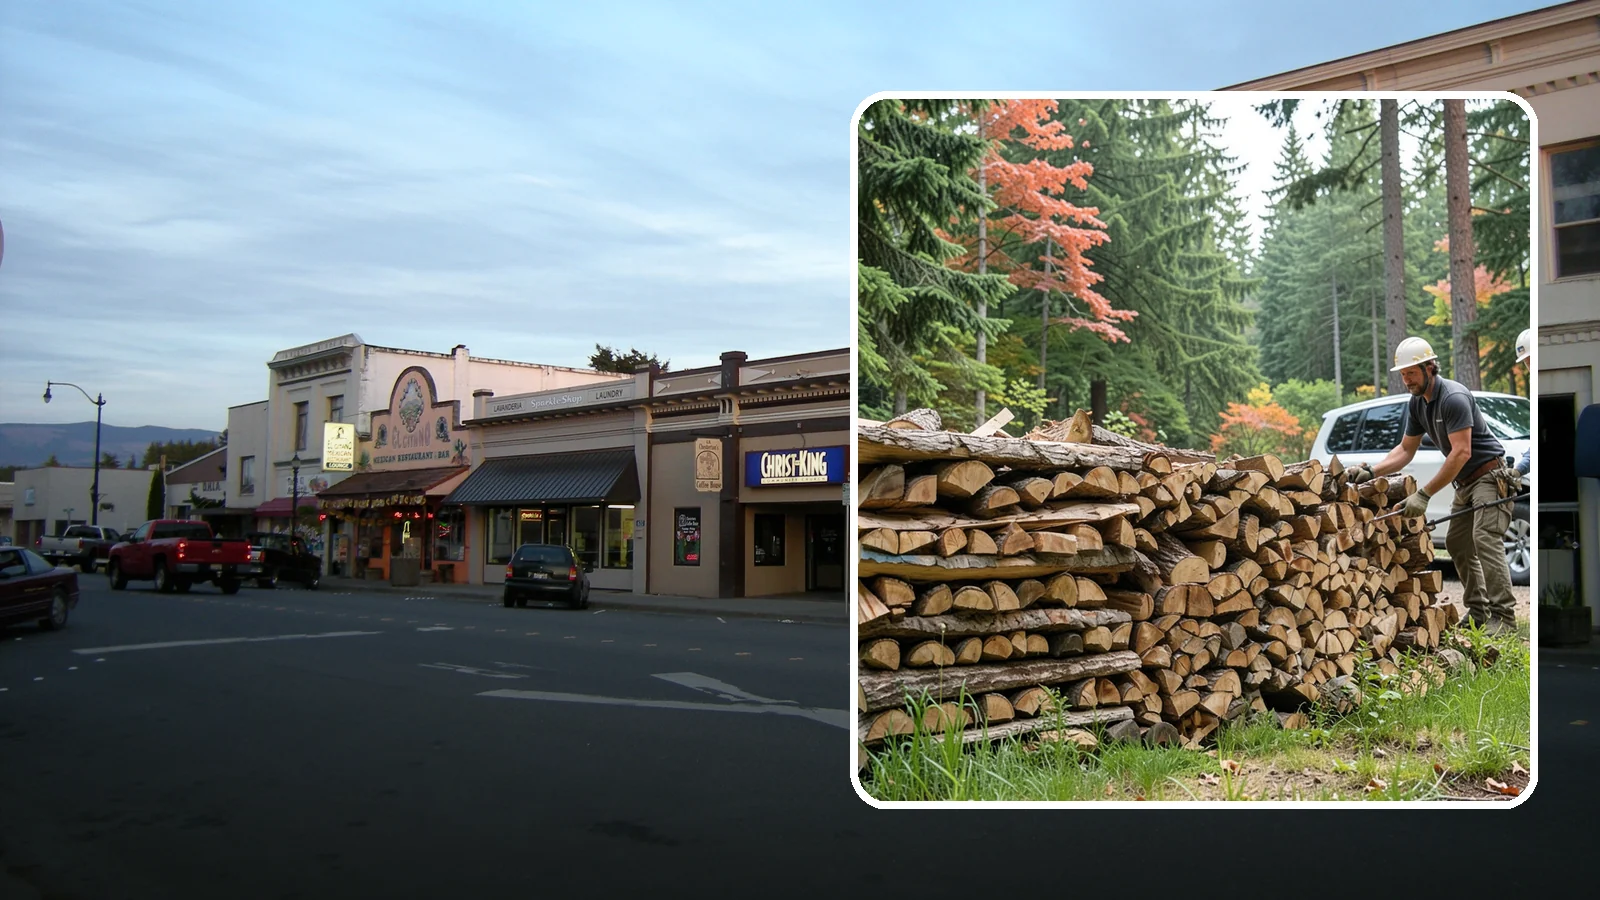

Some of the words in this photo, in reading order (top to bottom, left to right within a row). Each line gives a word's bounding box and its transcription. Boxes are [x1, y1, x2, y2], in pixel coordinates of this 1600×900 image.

[530, 397, 561, 409] Sparkle
[561, 394, 582, 405] Shop
[595, 389, 623, 400] LAUNDRY
[493, 402, 523, 413] LAVANDERIA
[373, 455, 396, 464] MEXICAN
[397, 451, 433, 462] RESTAURANT
[438, 450, 450, 459] BAR
[761, 452, 797, 478] CHRIST
[800, 450, 827, 476] KING
